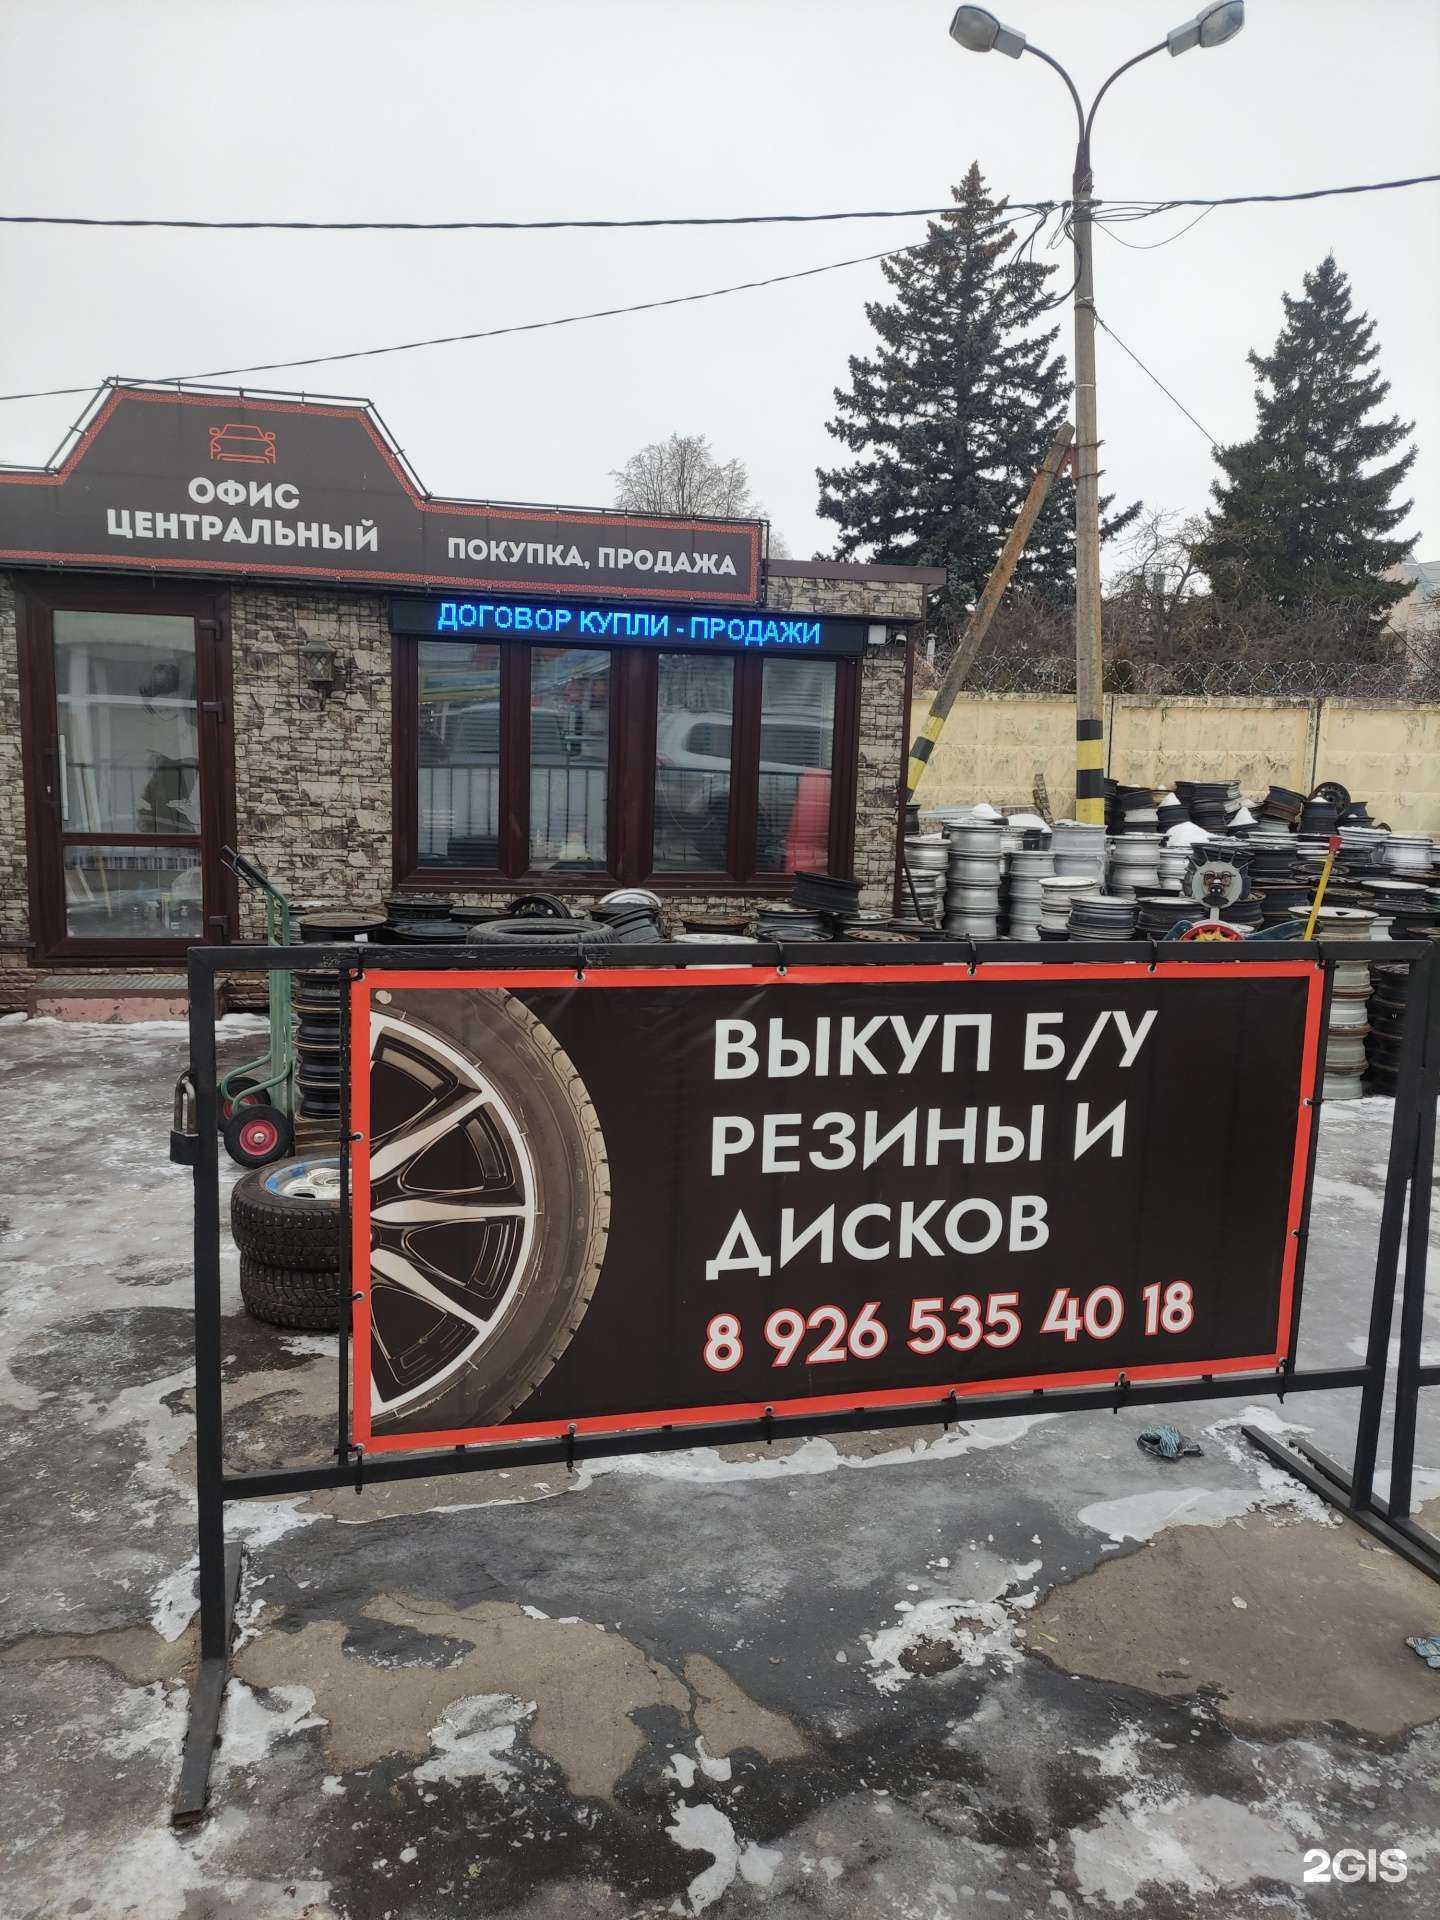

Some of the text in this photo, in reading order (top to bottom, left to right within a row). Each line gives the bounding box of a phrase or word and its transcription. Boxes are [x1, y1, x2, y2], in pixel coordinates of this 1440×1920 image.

[188, 477, 300, 510] ОФИС
[106, 508, 379, 552] ЦЕНТРАЛЬНЫЙ
[447, 537, 737, 577] ПОКУПКА, ПРОДАЖА
[437, 602, 572, 633] ДОГОВОР
[580, 611, 669, 638] КУПЛИ
[690, 616, 821, 646] ПРОДАЖИ
[713, 1010, 1158, 1081] ВЫКУП Б/У
[711, 1099, 1126, 1176] РЕЗИНЫ И
[705, 1195, 1050, 1281] ДИСКОВ
[703, 1280, 1194, 1372] 8 926 535 40 18
